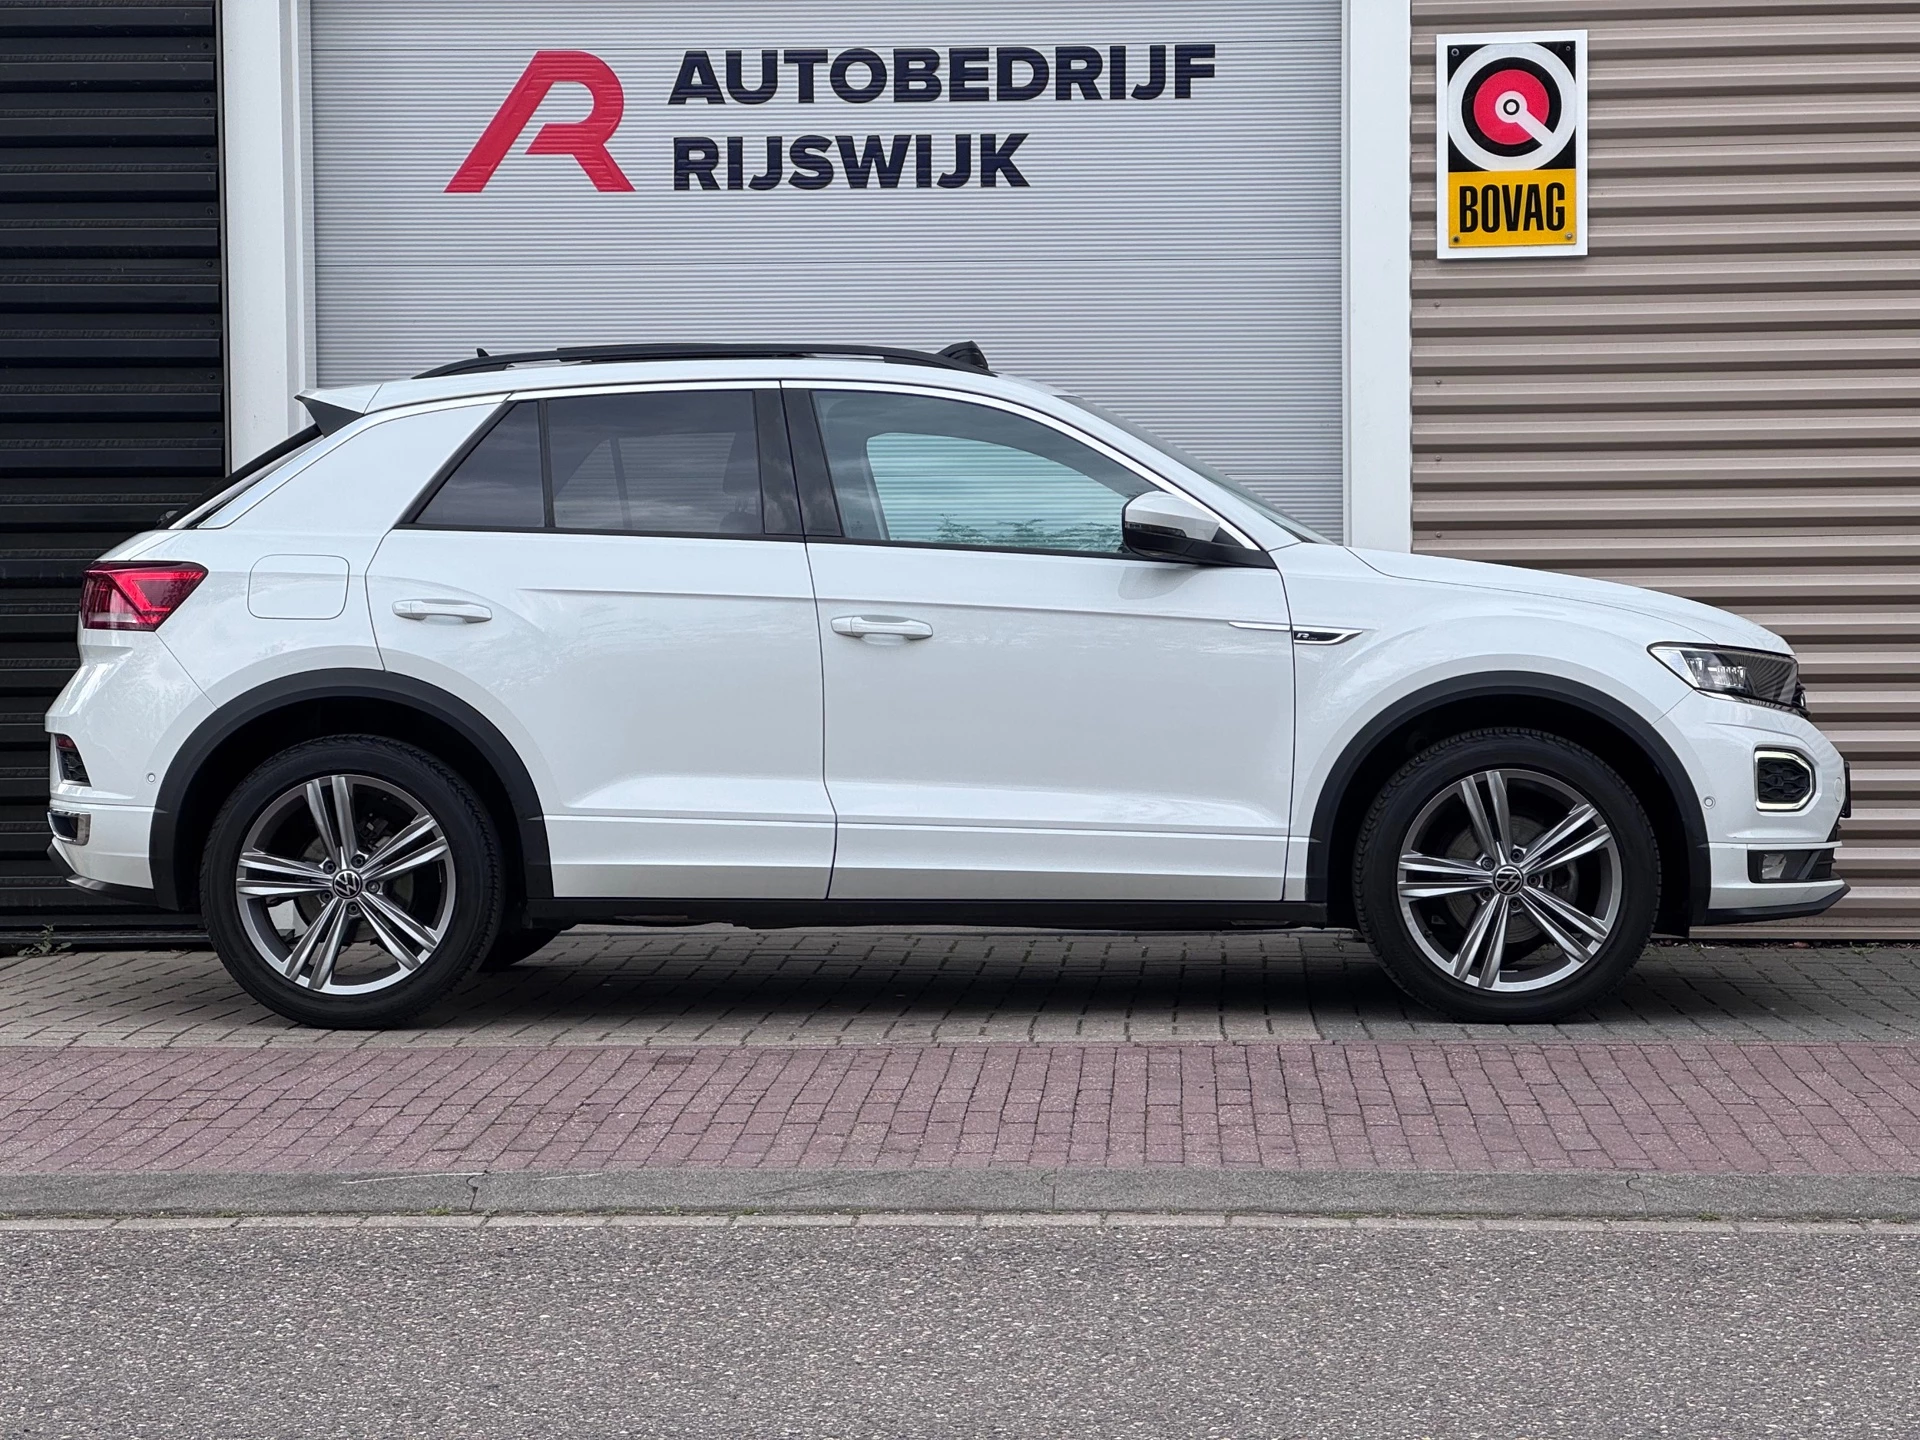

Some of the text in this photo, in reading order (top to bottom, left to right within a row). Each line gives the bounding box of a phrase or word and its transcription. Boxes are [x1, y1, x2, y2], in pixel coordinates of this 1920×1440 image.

[668, 45, 1216, 106] AUTOBEDRIJF
[672, 133, 1031, 192] RIJSWIJK
[1459, 182, 1566, 233] BOVAG
